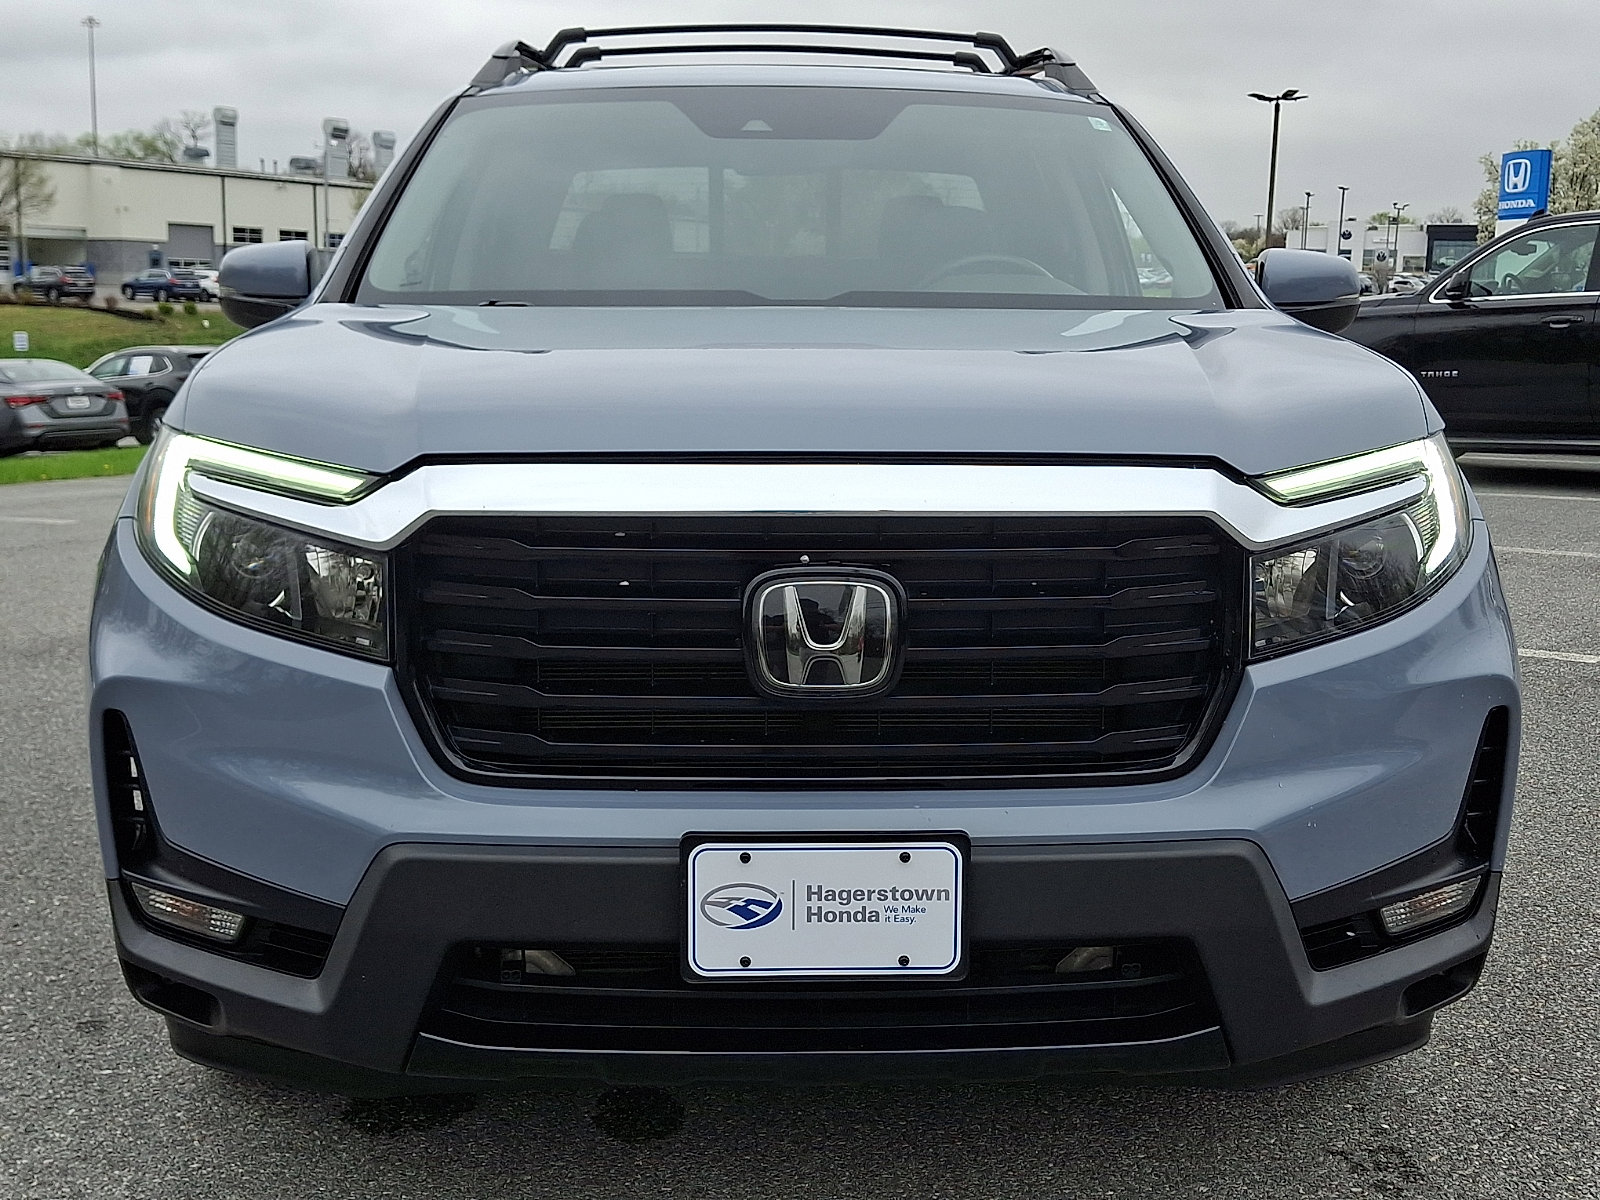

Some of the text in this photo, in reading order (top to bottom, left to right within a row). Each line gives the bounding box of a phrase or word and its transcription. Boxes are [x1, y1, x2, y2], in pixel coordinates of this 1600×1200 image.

[1498, 199, 1536, 209] HONDA
[1420, 370, 1459, 378] TAHOE
[806, 884, 950, 906] Hagerstown
[806, 905, 880, 923] Honda
[883, 904, 927, 914] We Make
[884, 914, 917, 925] it Easy.
